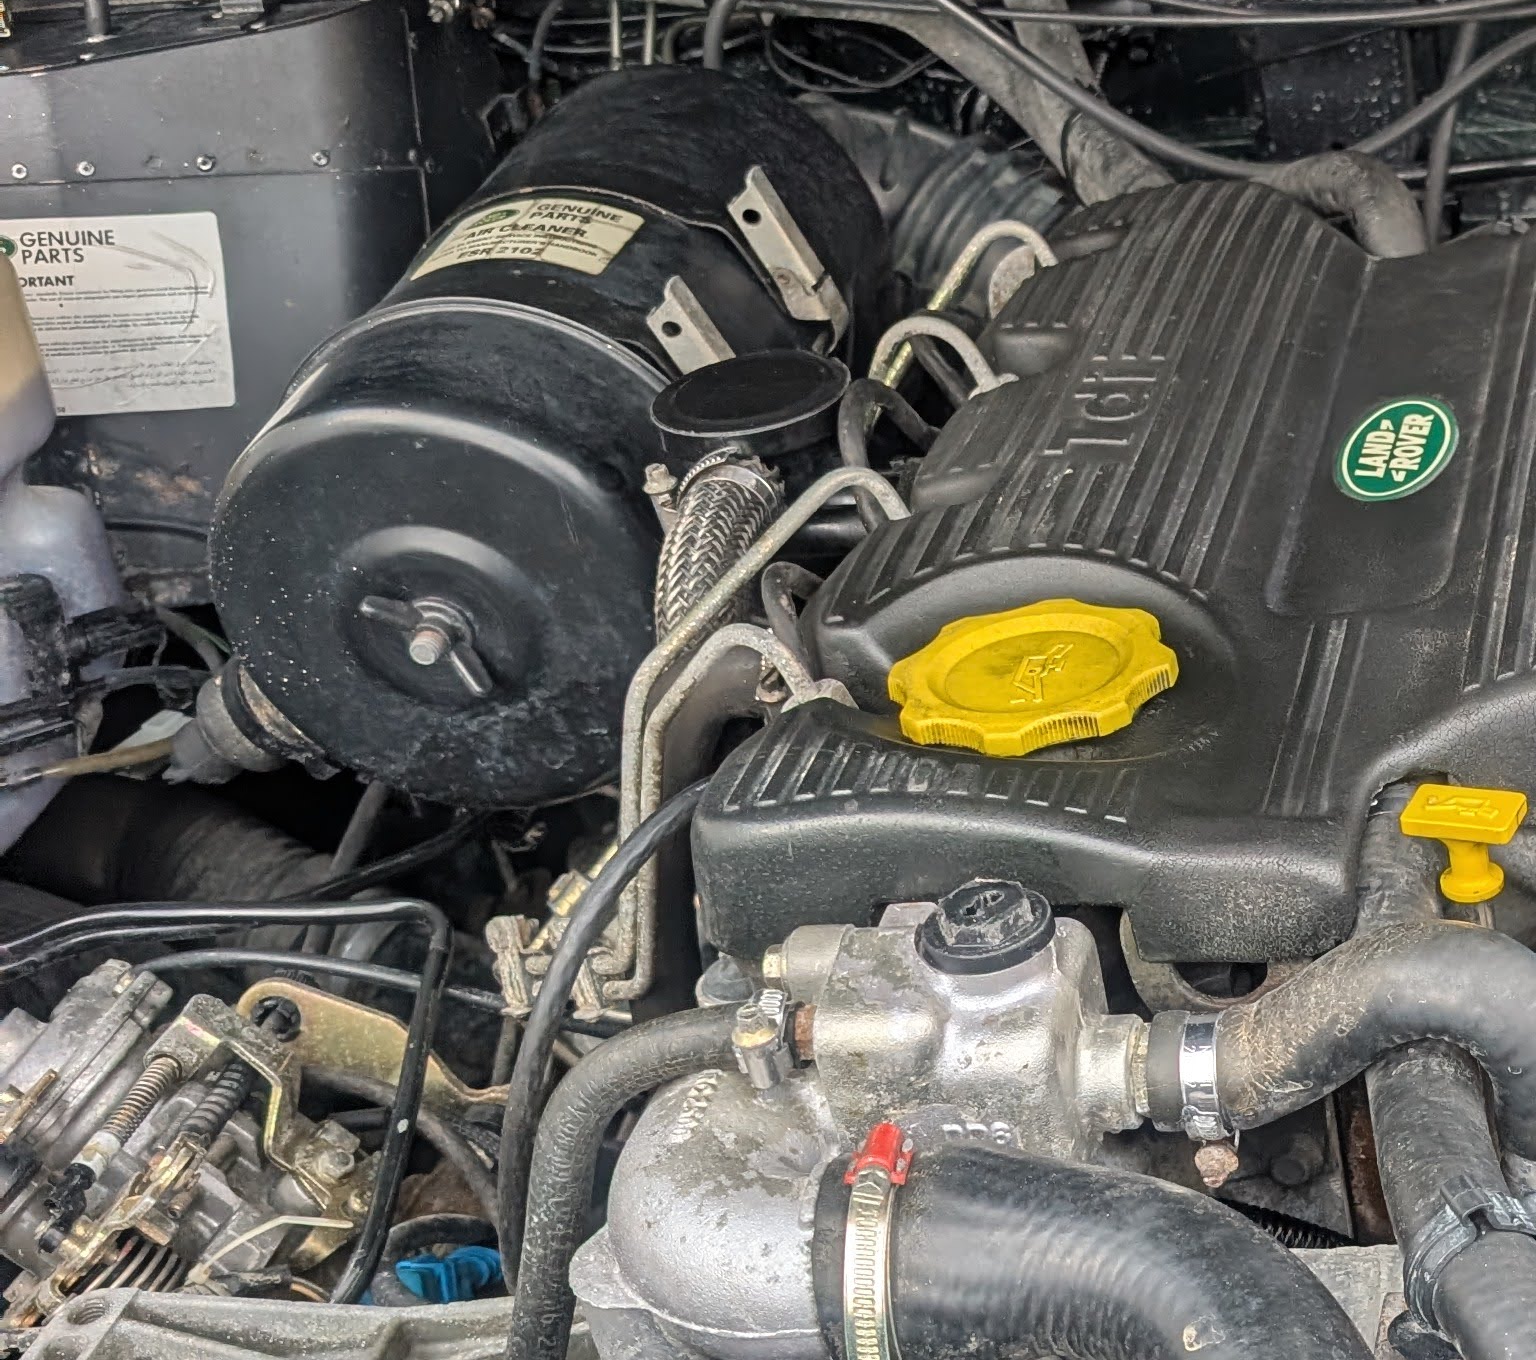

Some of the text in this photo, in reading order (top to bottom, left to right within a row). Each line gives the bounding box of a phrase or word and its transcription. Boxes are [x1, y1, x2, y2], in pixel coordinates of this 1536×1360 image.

[529, 211, 592, 224] PARTS
[537, 203, 624, 222] GENUINE
[19, 229, 116, 248] GENUINE
[464, 223, 588, 241] AIR CLEANER
[21, 247, 85, 265] PARTS
[18, 275, 75, 288] ORTANT
[1388, 413, 1435, 471] ROVER
[1354, 430, 1397, 479] LAND
